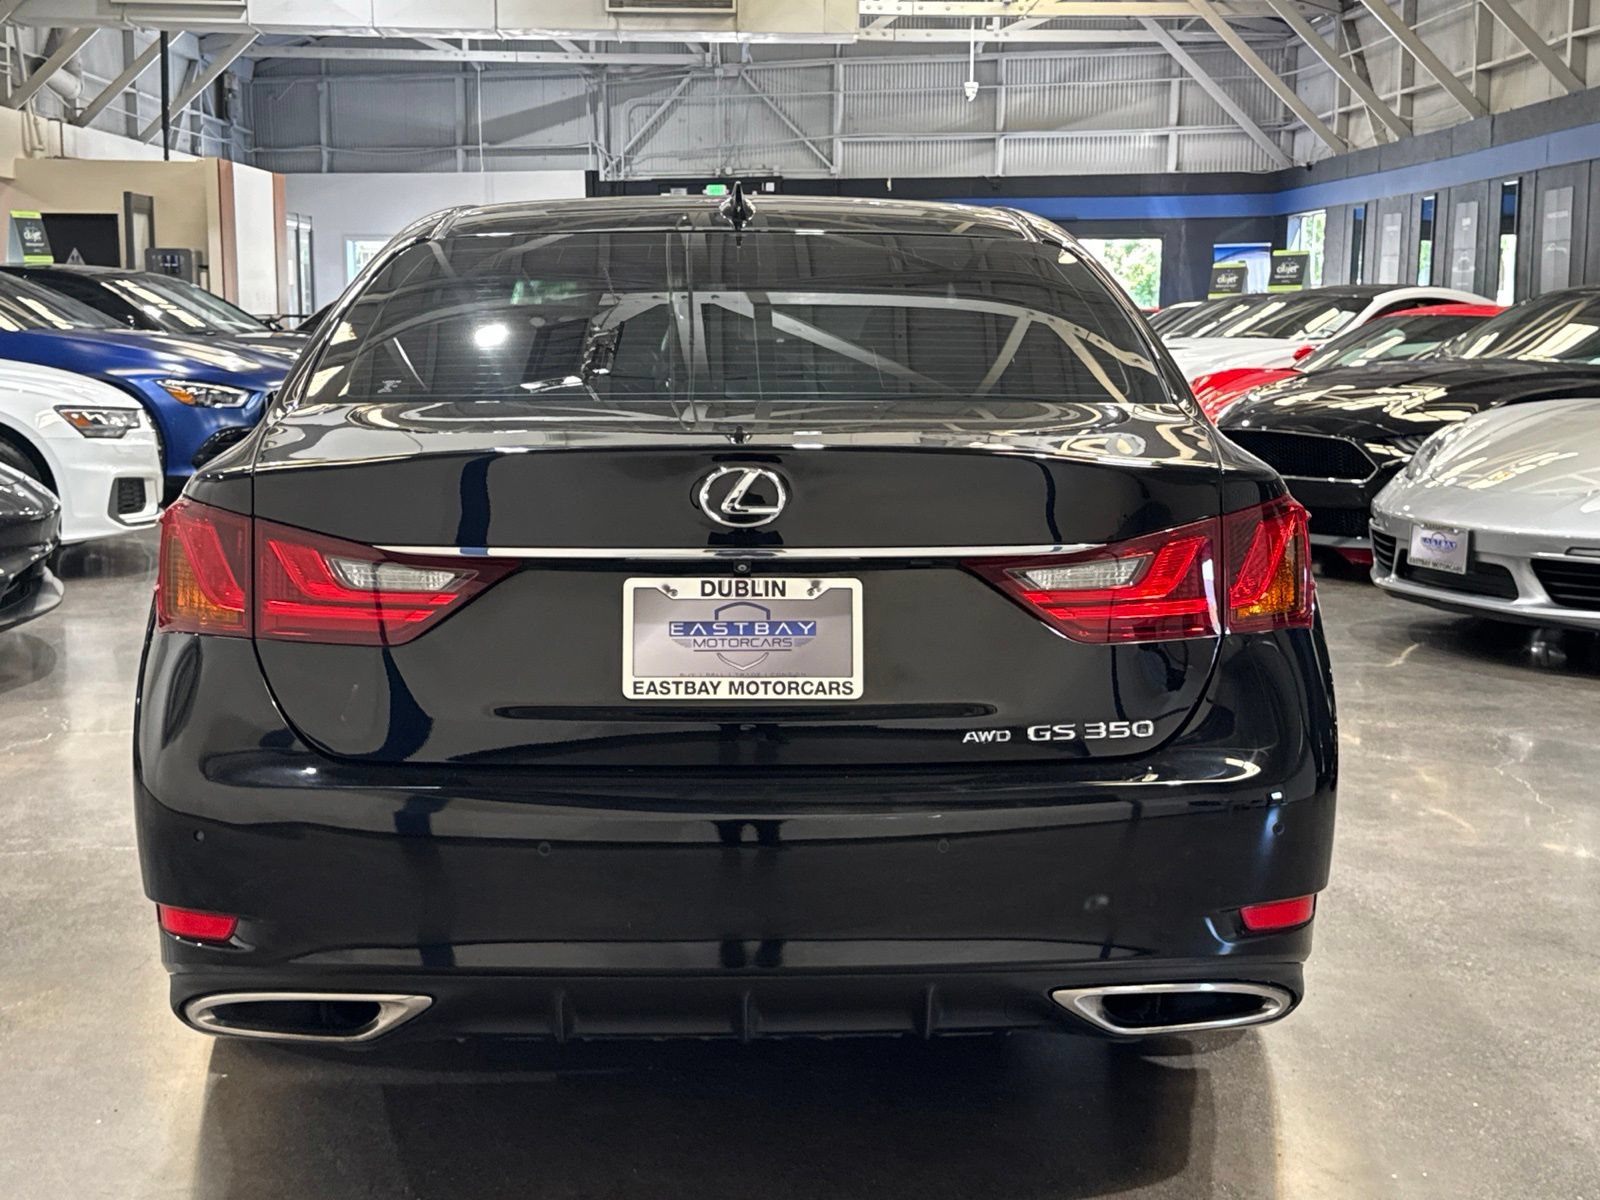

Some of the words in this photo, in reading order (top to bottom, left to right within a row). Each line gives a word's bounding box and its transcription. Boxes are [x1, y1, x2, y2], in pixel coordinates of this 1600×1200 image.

[700, 580, 787, 597] DUBLIN
[670, 622, 815, 635] EASTBAY
[692, 638, 793, 649] MOTORCARS
[632, 680, 722, 696] EASTBAY
[728, 680, 855, 696] MOTORCARS
[962, 730, 1011, 743] AWD
[1027, 723, 1076, 741] GS
[1084, 719, 1155, 740] 350
